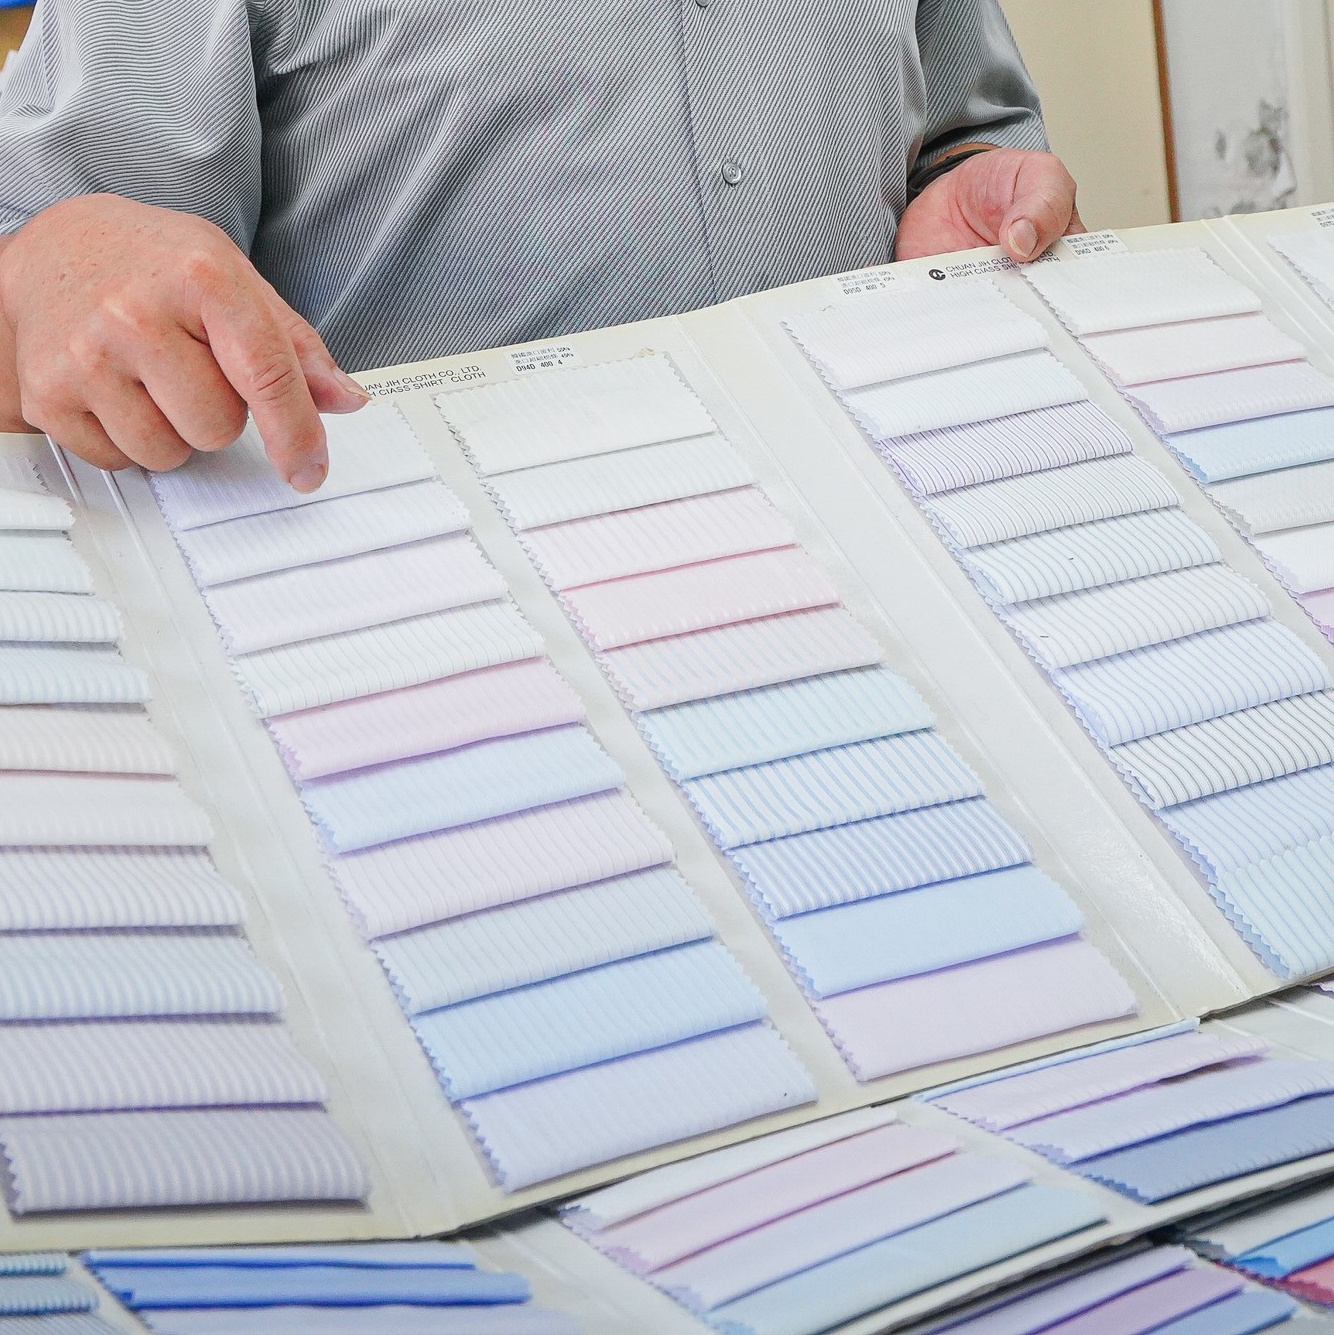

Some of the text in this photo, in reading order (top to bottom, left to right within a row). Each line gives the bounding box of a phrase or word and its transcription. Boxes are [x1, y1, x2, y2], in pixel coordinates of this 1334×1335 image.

[945, 257, 1013, 273] CHUAN JIH CLOT
[950, 269, 973, 279] HIGH
[541, 360, 554, 369] 400
[386, 379, 401, 388] JIH
[402, 372, 437, 385] CLOTH
[451, 371, 486, 383] CLOTH
